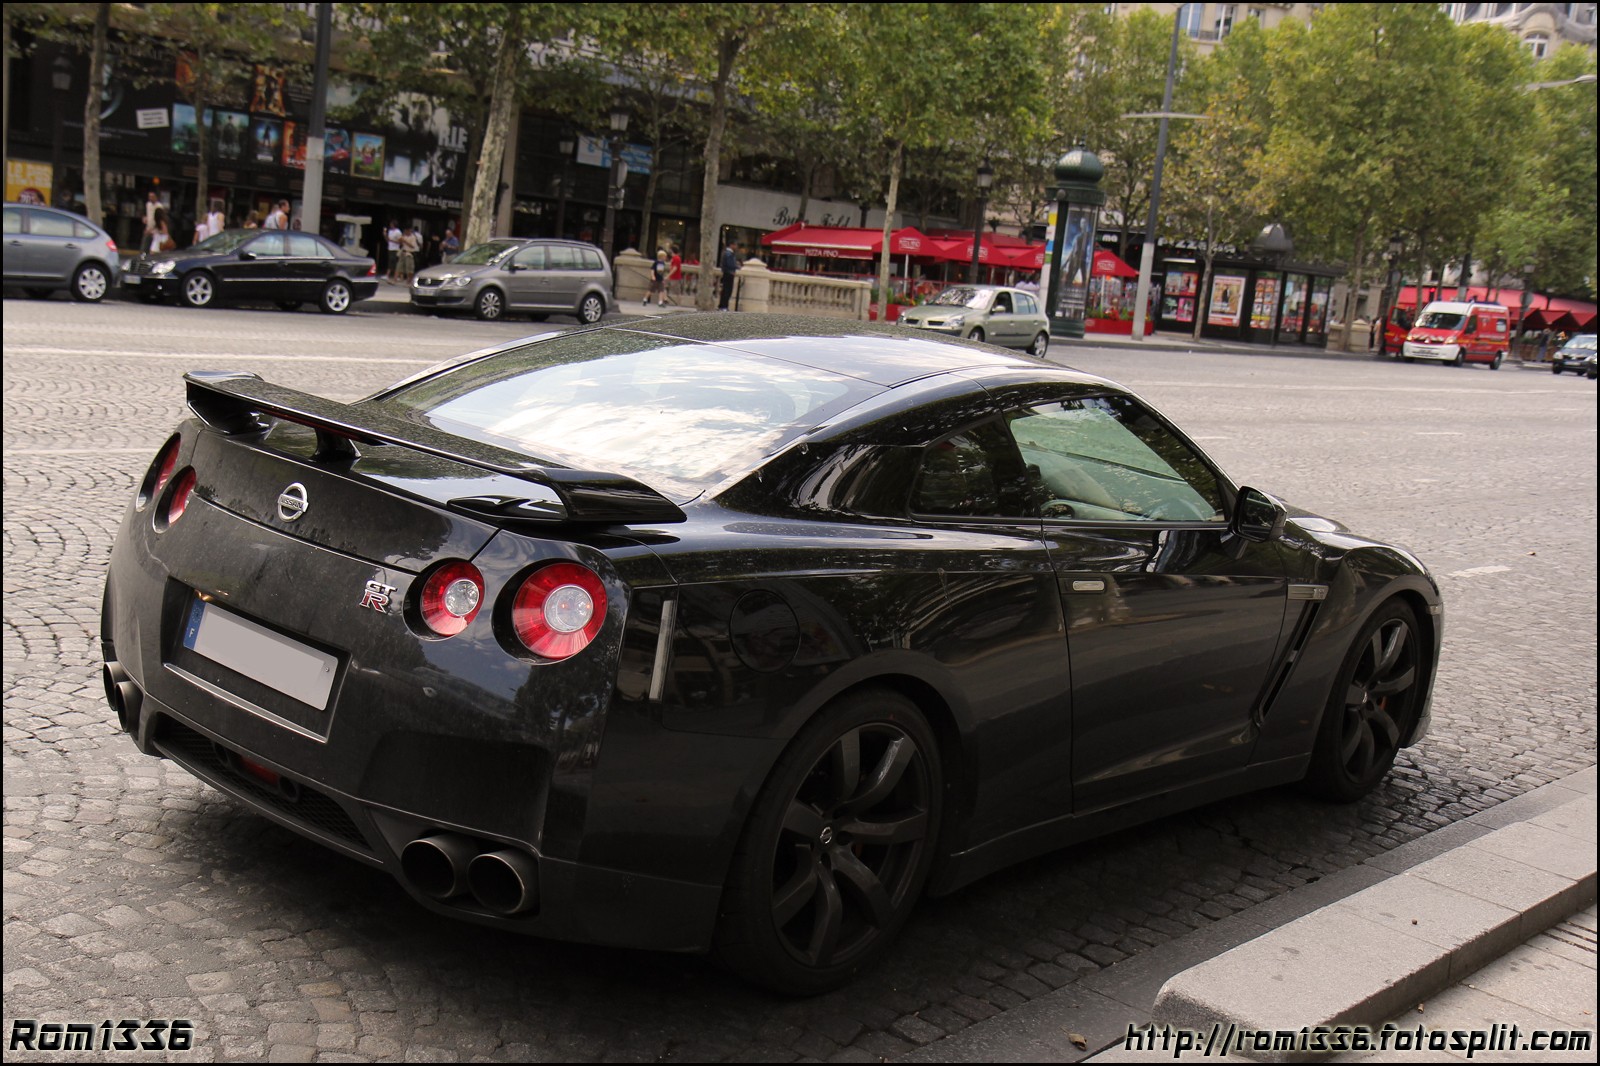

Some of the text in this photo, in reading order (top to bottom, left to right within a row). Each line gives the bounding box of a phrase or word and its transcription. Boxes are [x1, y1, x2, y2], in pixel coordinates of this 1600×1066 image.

[805, 248, 822, 256] PIZZA
[280, 496, 303, 508] NISSAN
[366, 579, 398, 596] GT
[359, 589, 389, 613] R
